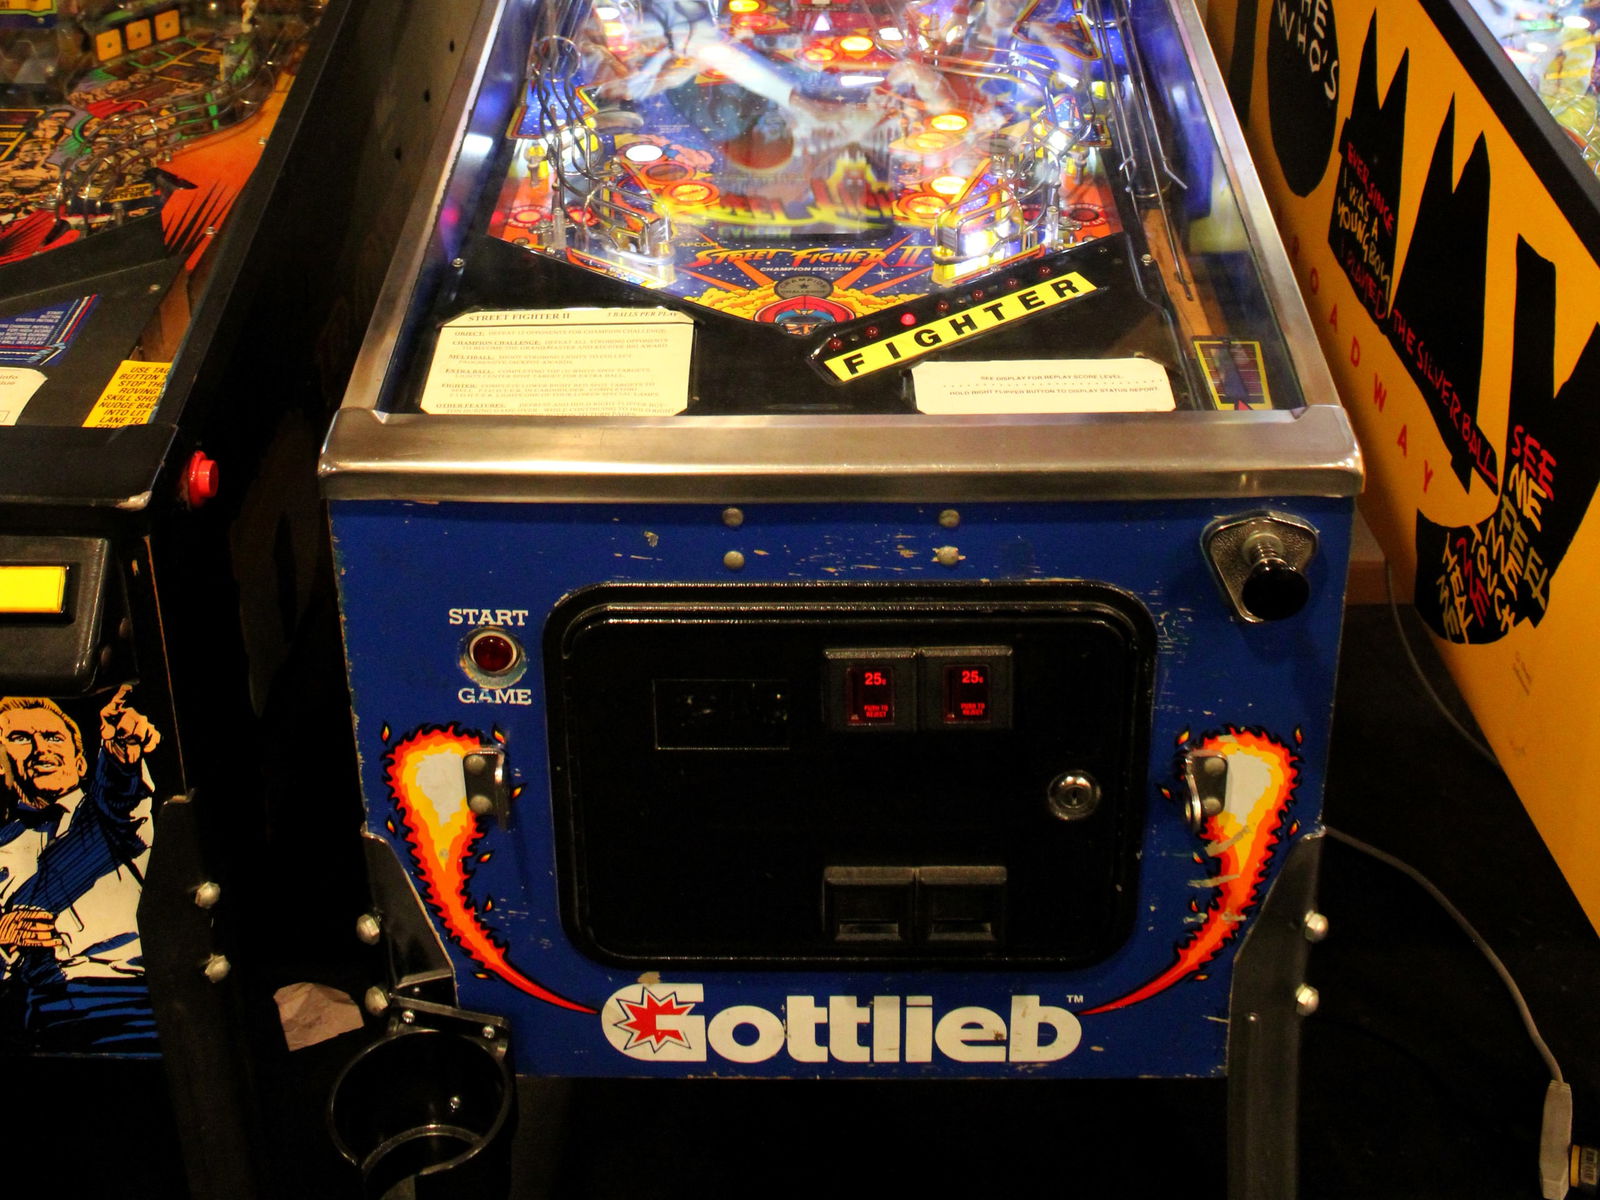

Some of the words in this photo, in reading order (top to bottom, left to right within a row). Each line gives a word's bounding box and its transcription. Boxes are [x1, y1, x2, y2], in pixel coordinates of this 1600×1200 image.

[1347, 142, 1370, 191] EVER
[1368, 183, 1394, 236] SINCE
[685, 247, 796, 268] STREET
[791, 247, 889, 268] FIGHTER
[468, 313, 508, 322] STREET
[512, 312, 559, 320] FIGHTER
[843, 279, 1079, 375] FIGHTER
[130, 366, 151, 374] USE
[98, 401, 135, 409] NUDGE
[135, 394, 158, 402] SHO
[1393, 308, 1414, 347] THE
[1417, 341, 1462, 427] SILVER
[1461, 412, 1498, 485] BALL
[99, 416, 128, 424] LANE
[1511, 425, 1557, 501] SEE
[1509, 462, 1547, 533] ME
[448, 608, 529, 626] START
[458, 688, 532, 706] GAME
[601, 983, 1082, 1063] Gottlieb
